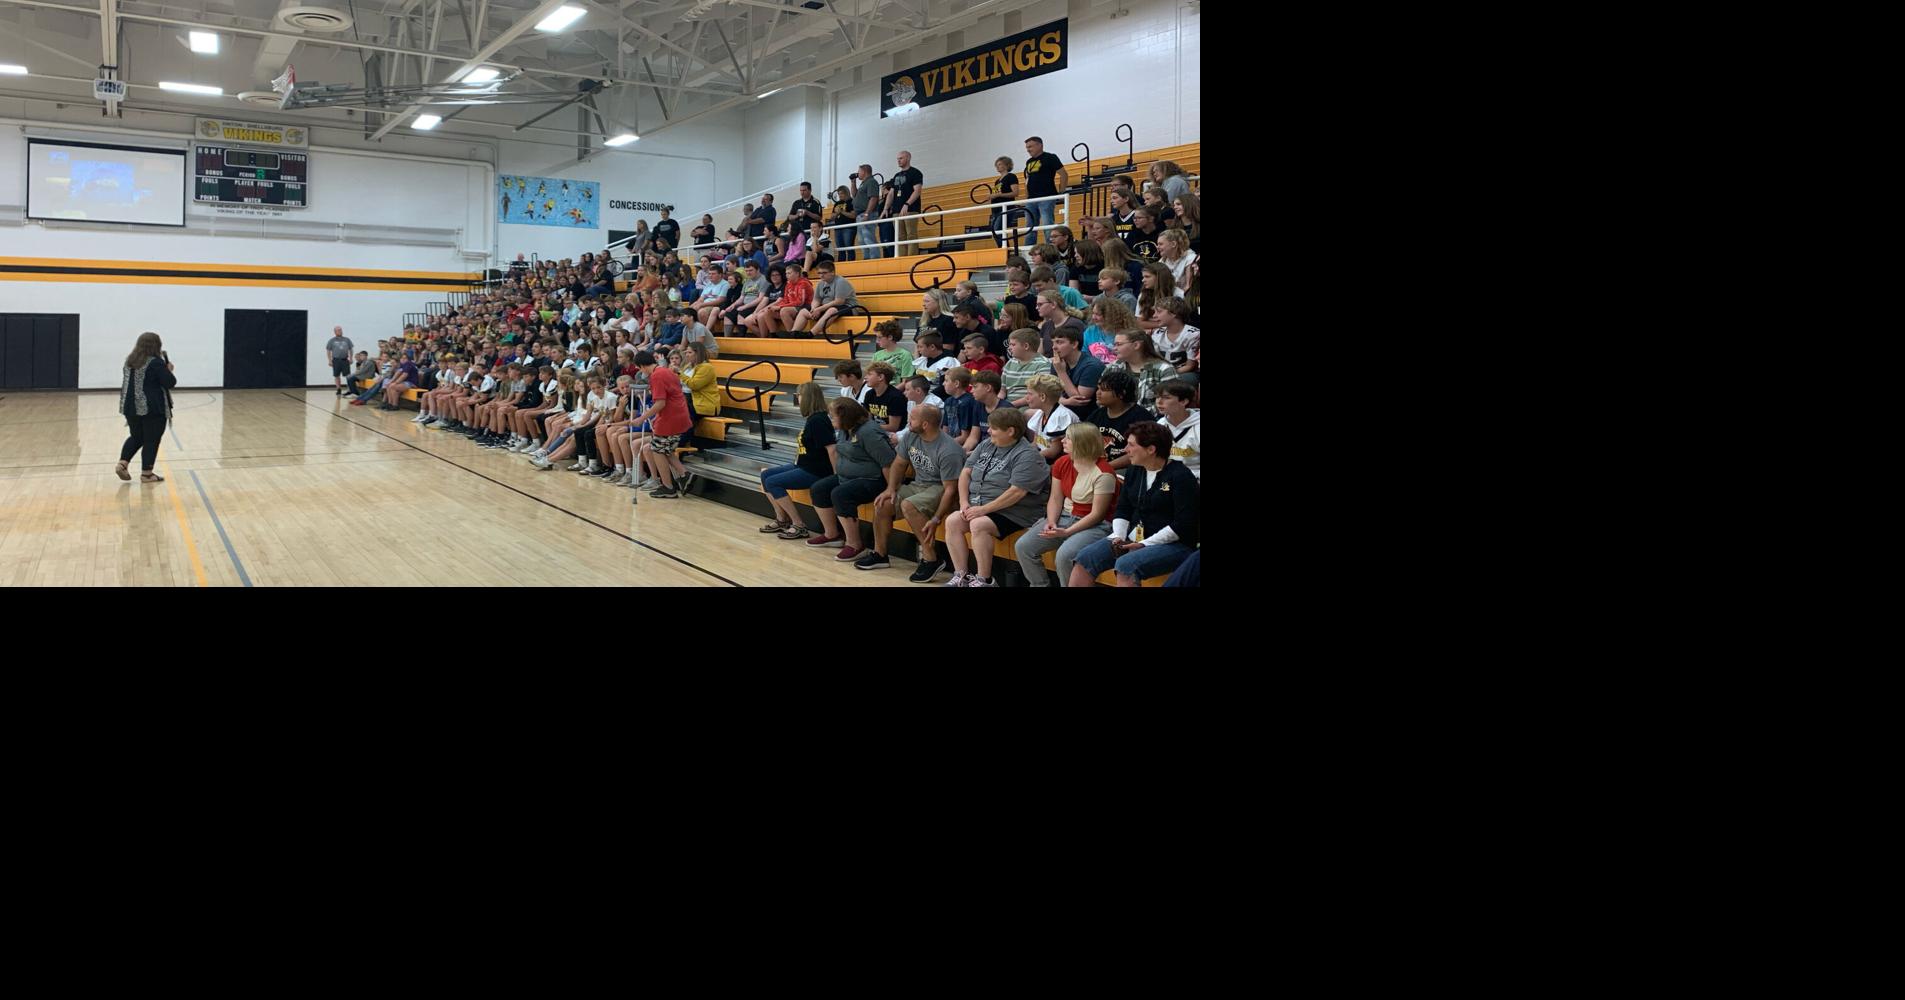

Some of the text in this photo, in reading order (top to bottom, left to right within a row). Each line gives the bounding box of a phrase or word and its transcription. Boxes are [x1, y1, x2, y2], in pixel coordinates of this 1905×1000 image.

[920, 30, 1062, 97] VIKINGS
[223, 128, 282, 144] VIKINGS
[198, 148, 222, 156] HOME
[609, 199, 667, 212] CONCESSIONS
